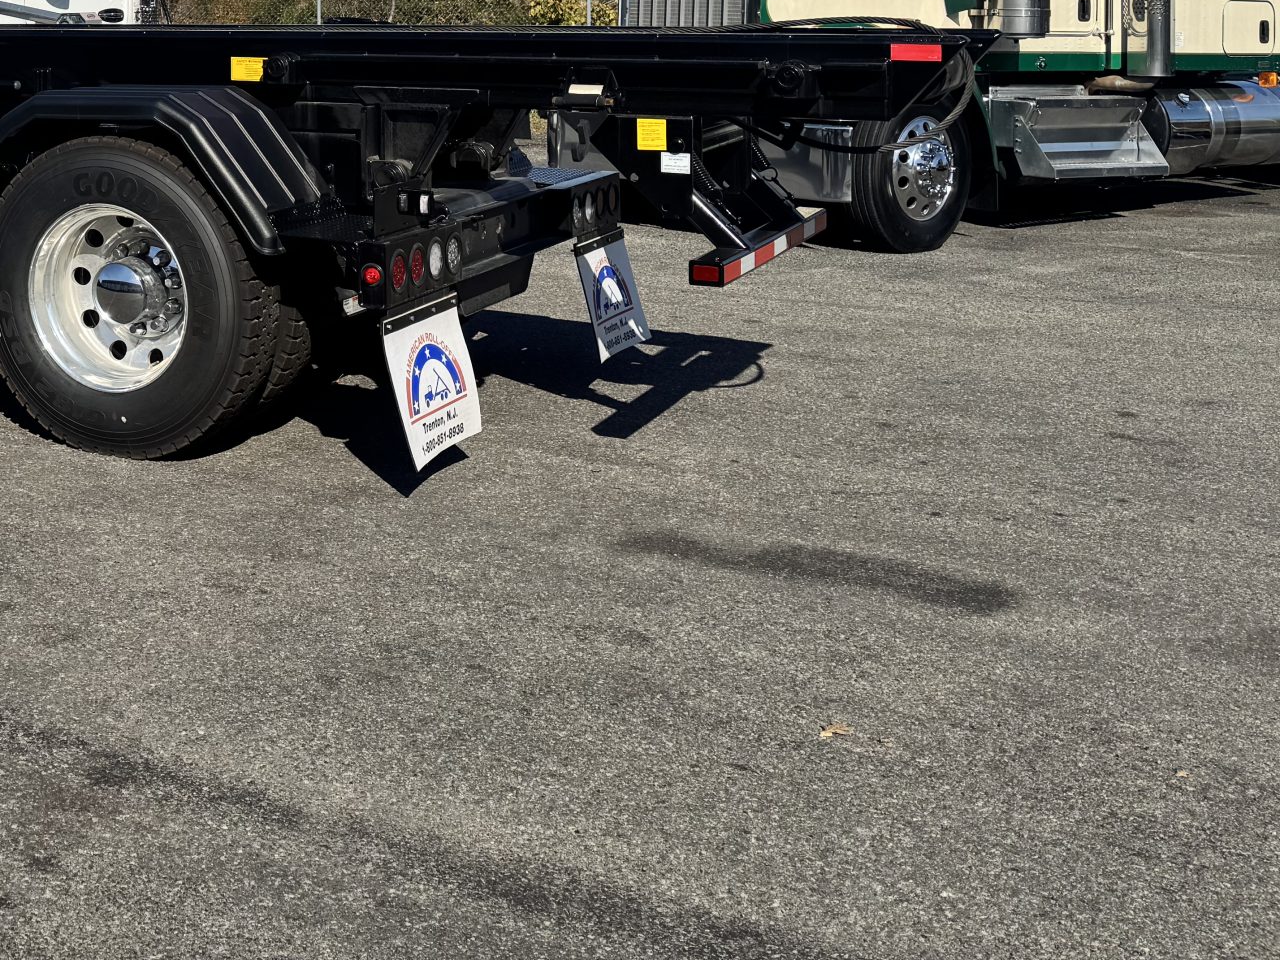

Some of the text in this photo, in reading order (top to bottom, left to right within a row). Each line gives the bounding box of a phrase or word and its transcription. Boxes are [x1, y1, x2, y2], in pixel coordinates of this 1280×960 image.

[422, 407, 458, 434] Trenton, N.J.
[422, 422, 465, 456] 1-800-851-8938
